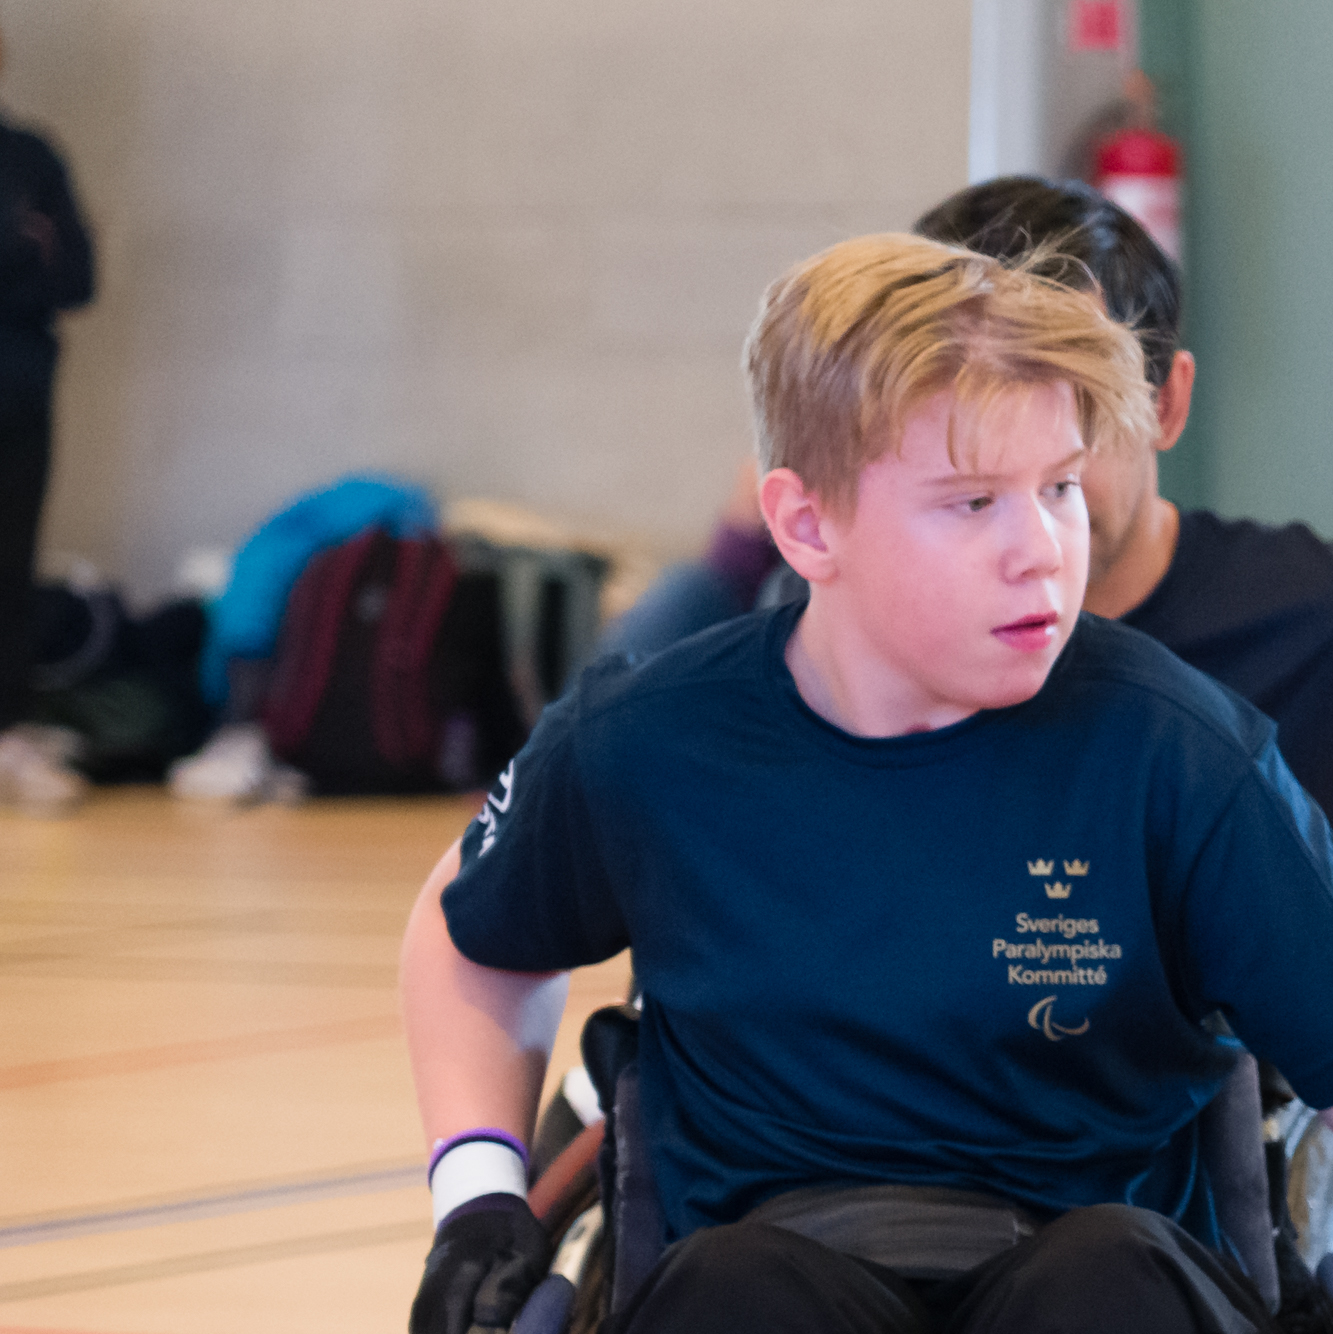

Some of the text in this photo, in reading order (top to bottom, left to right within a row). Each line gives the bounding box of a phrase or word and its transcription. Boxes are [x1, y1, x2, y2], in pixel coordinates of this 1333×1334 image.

[1015, 912, 1099, 939] Sveriges
[992, 938, 1122, 965] Paralympiska
[1008, 964, 1107, 985] Kommitté
